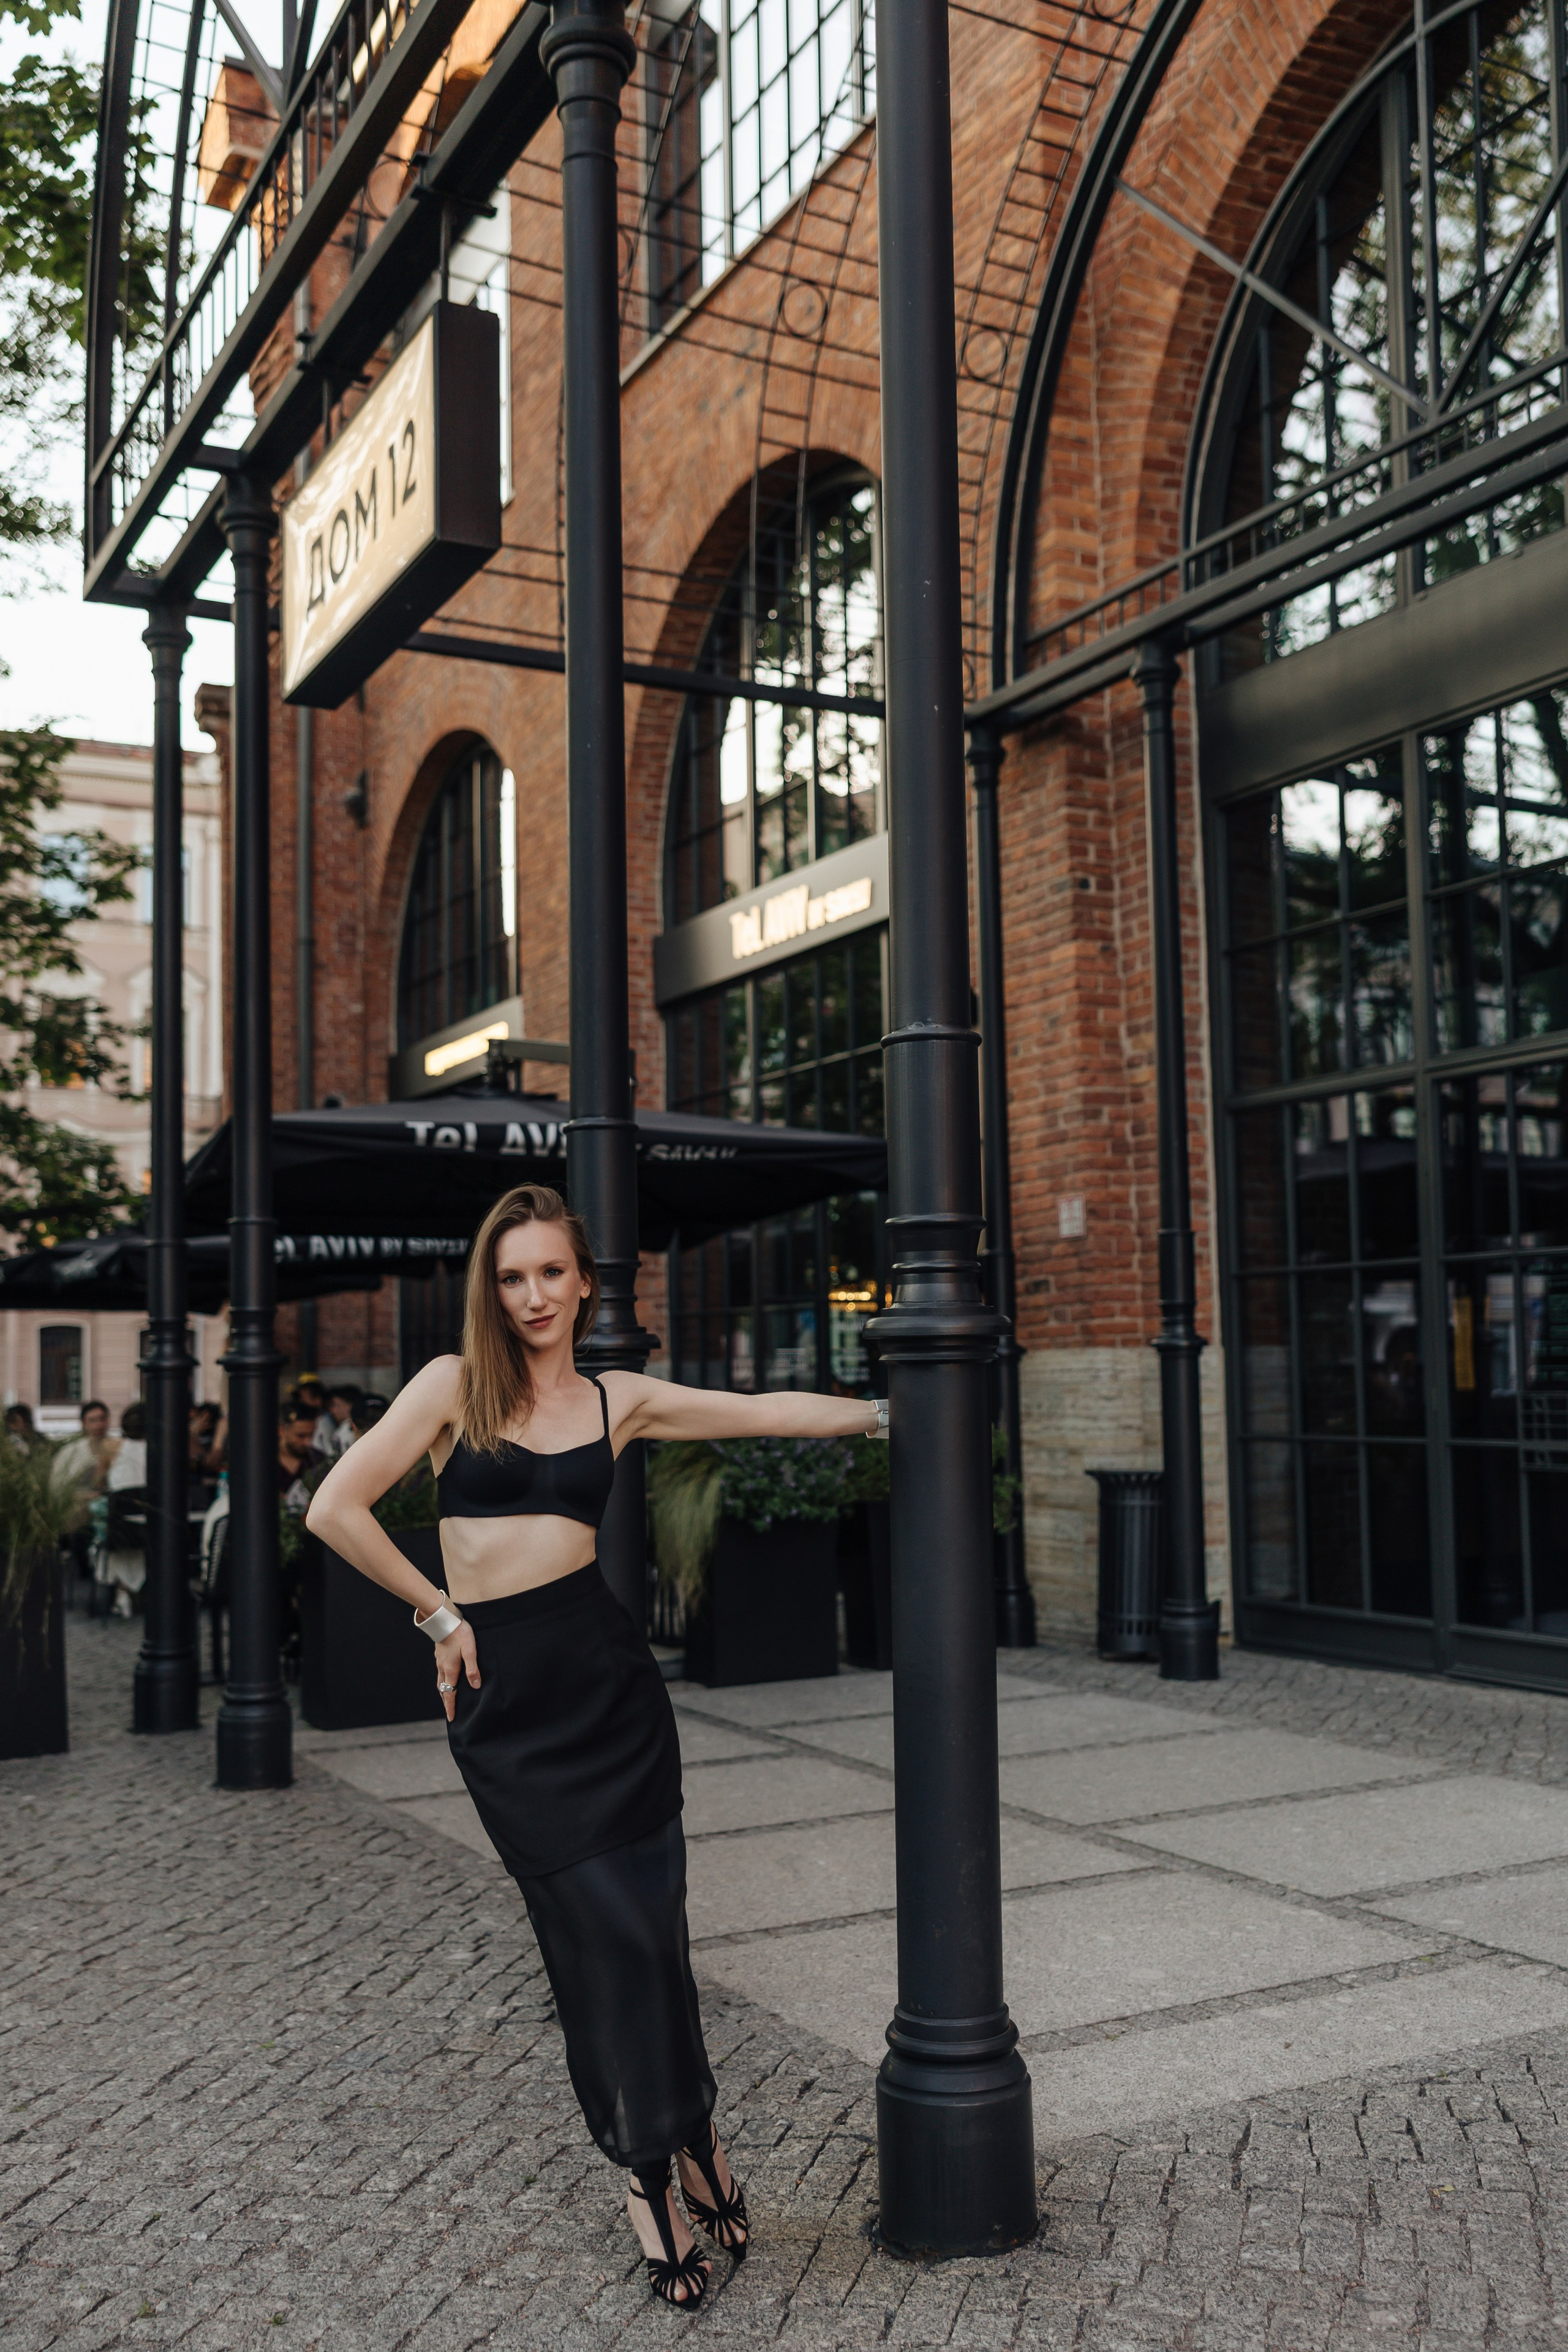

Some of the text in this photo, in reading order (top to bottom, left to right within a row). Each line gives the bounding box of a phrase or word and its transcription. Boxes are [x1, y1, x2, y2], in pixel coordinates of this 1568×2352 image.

[306, 420, 417, 623] ДОМ 12
[308, 1235, 375, 1259] AVIV
